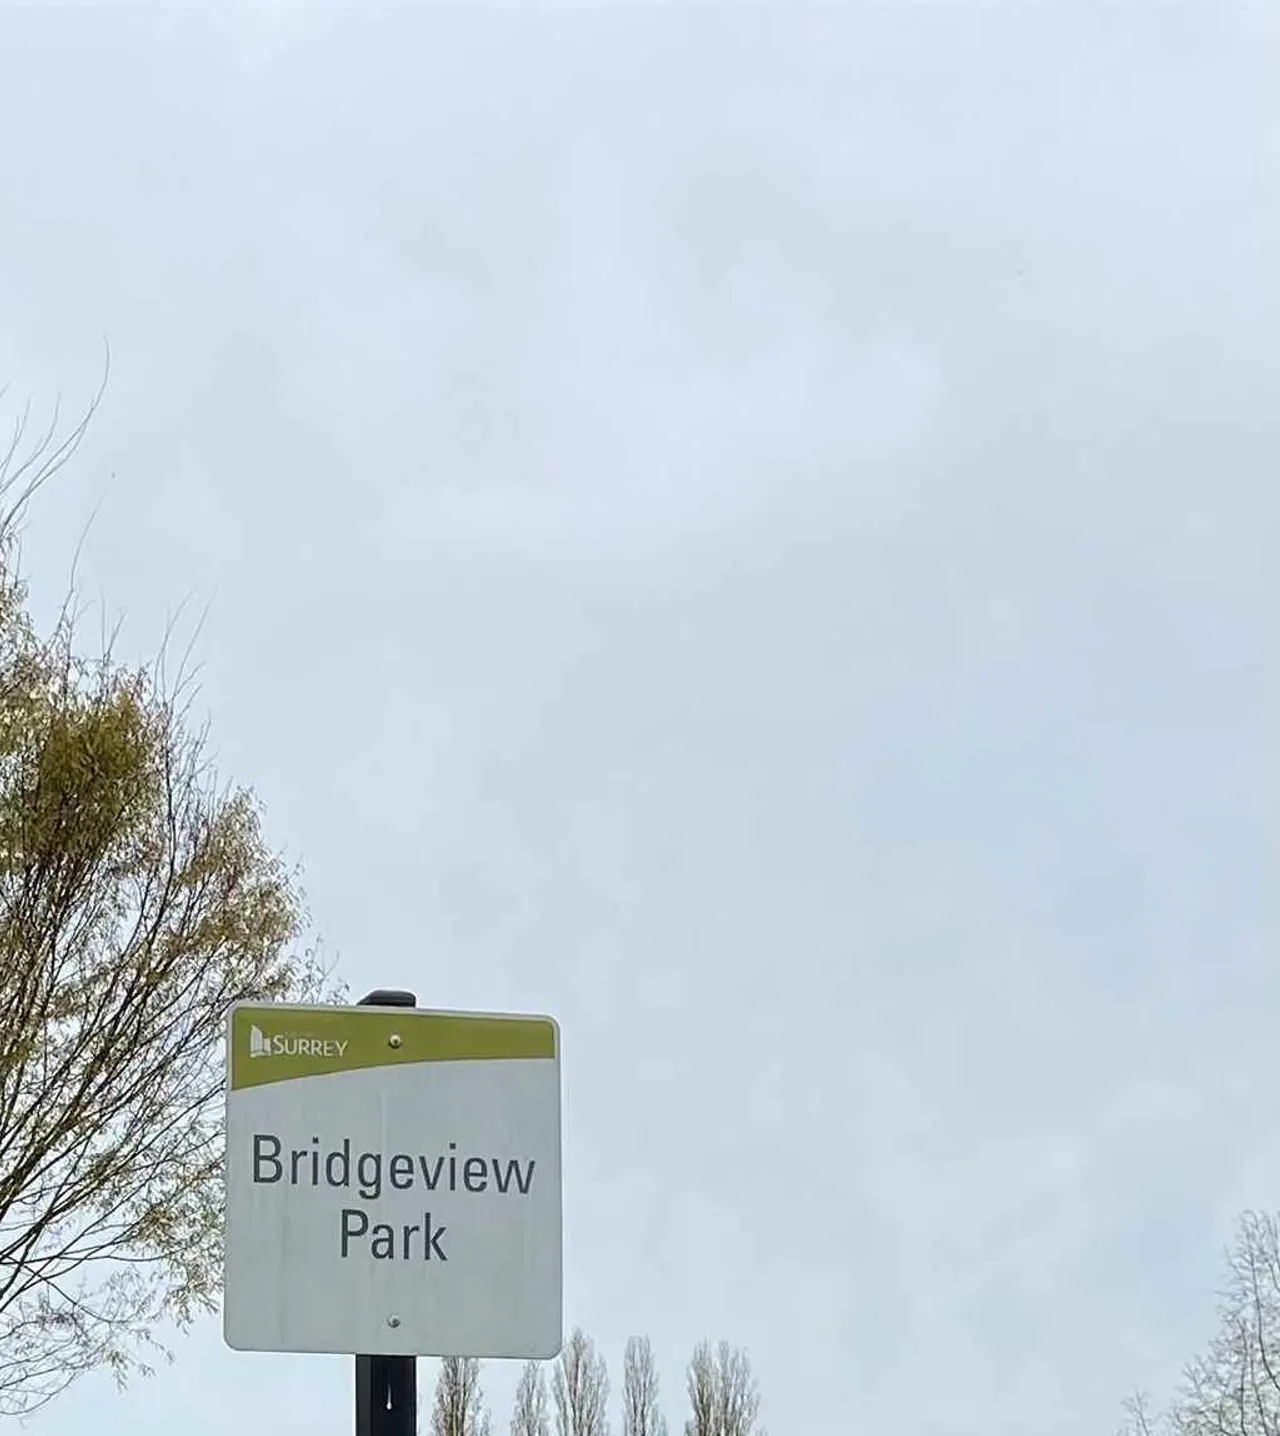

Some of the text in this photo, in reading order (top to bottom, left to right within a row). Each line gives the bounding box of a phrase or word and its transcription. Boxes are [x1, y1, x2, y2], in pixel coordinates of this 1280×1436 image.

[272, 1034, 349, 1057] SURREY
[252, 1134, 537, 1200] Bridgeview
[339, 1208, 449, 1262] Park
